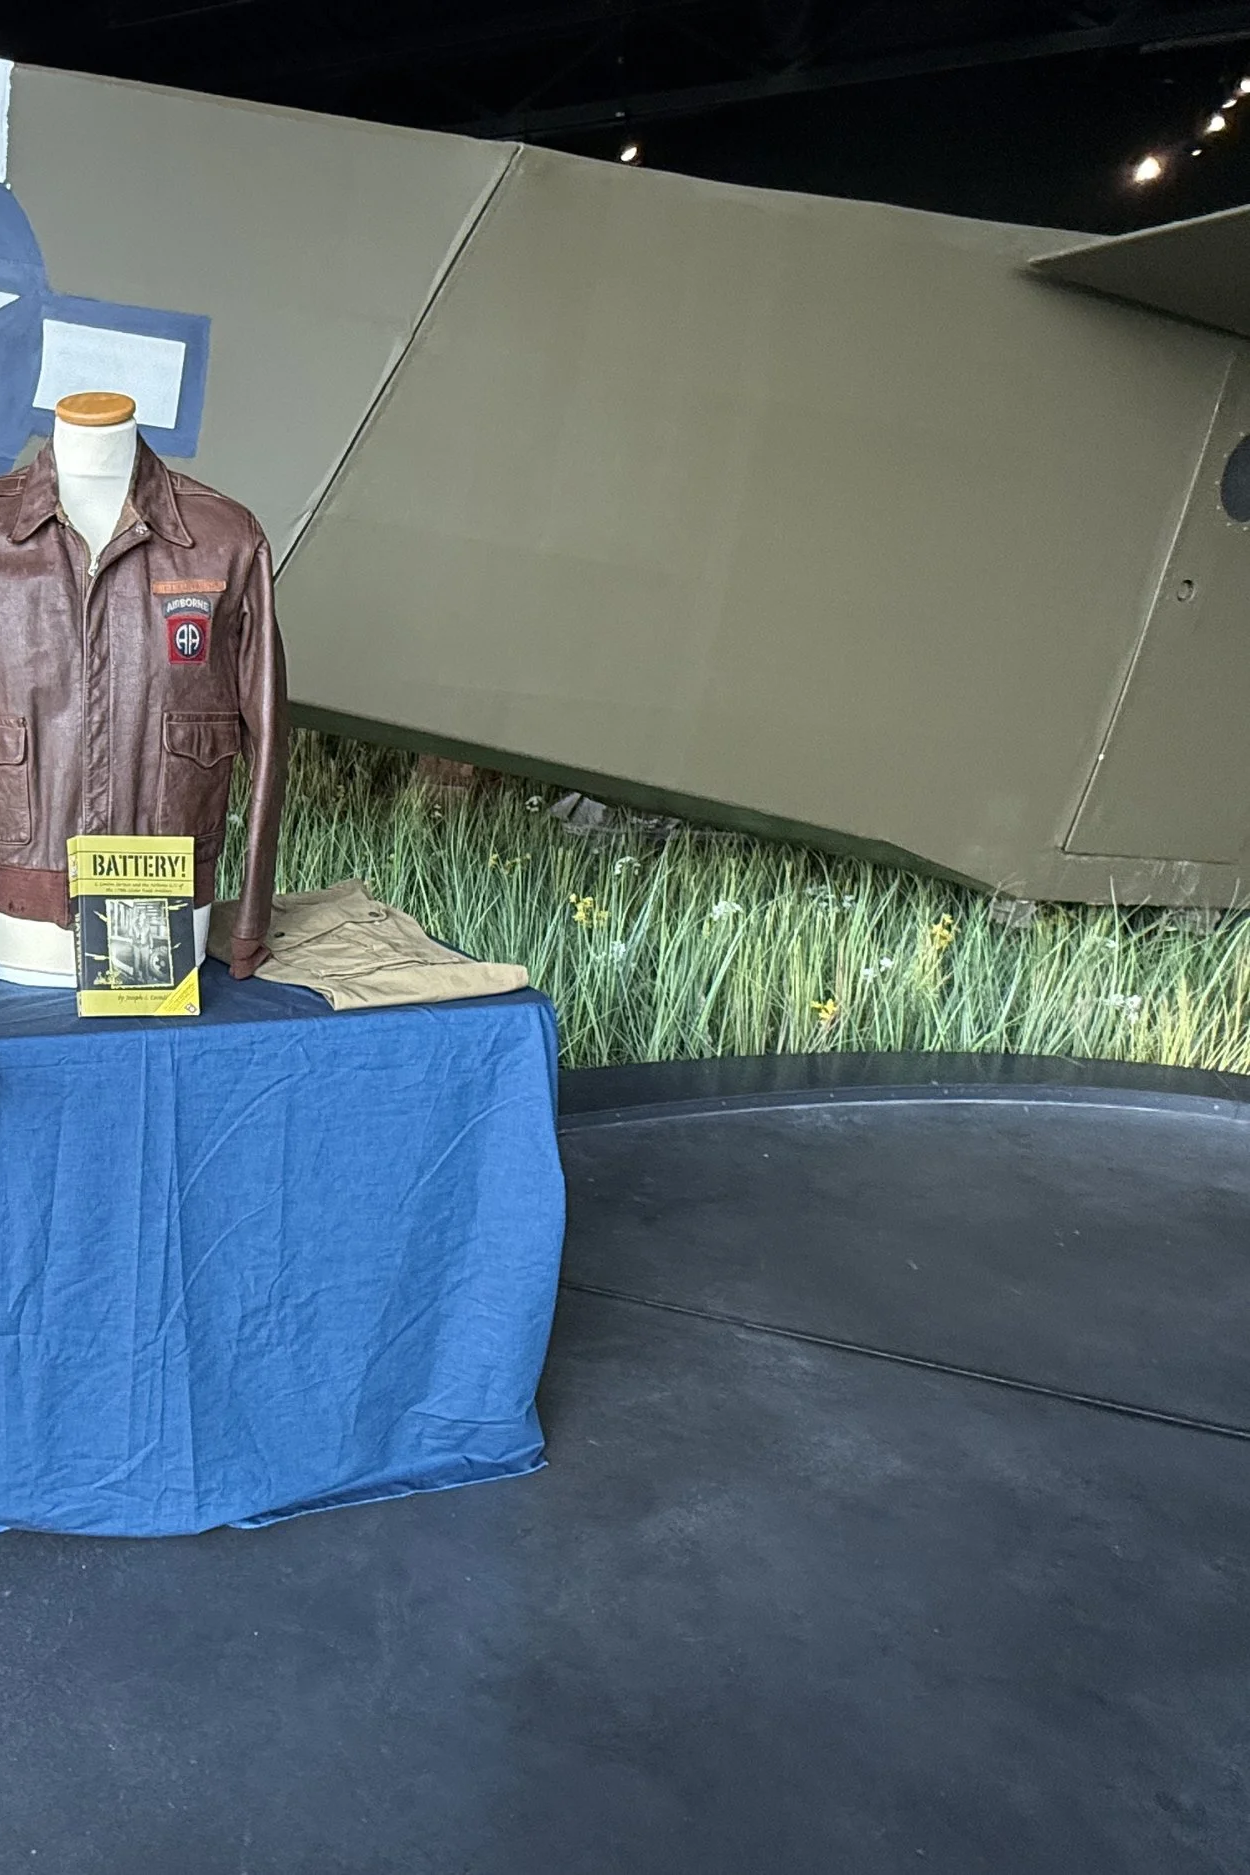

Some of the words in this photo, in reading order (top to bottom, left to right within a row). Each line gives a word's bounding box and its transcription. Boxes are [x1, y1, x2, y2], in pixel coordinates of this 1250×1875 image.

[166, 597, 210, 613] AIRBORNE
[176, 624, 200, 655] AA
[93, 854, 186, 877] BATTERY!
